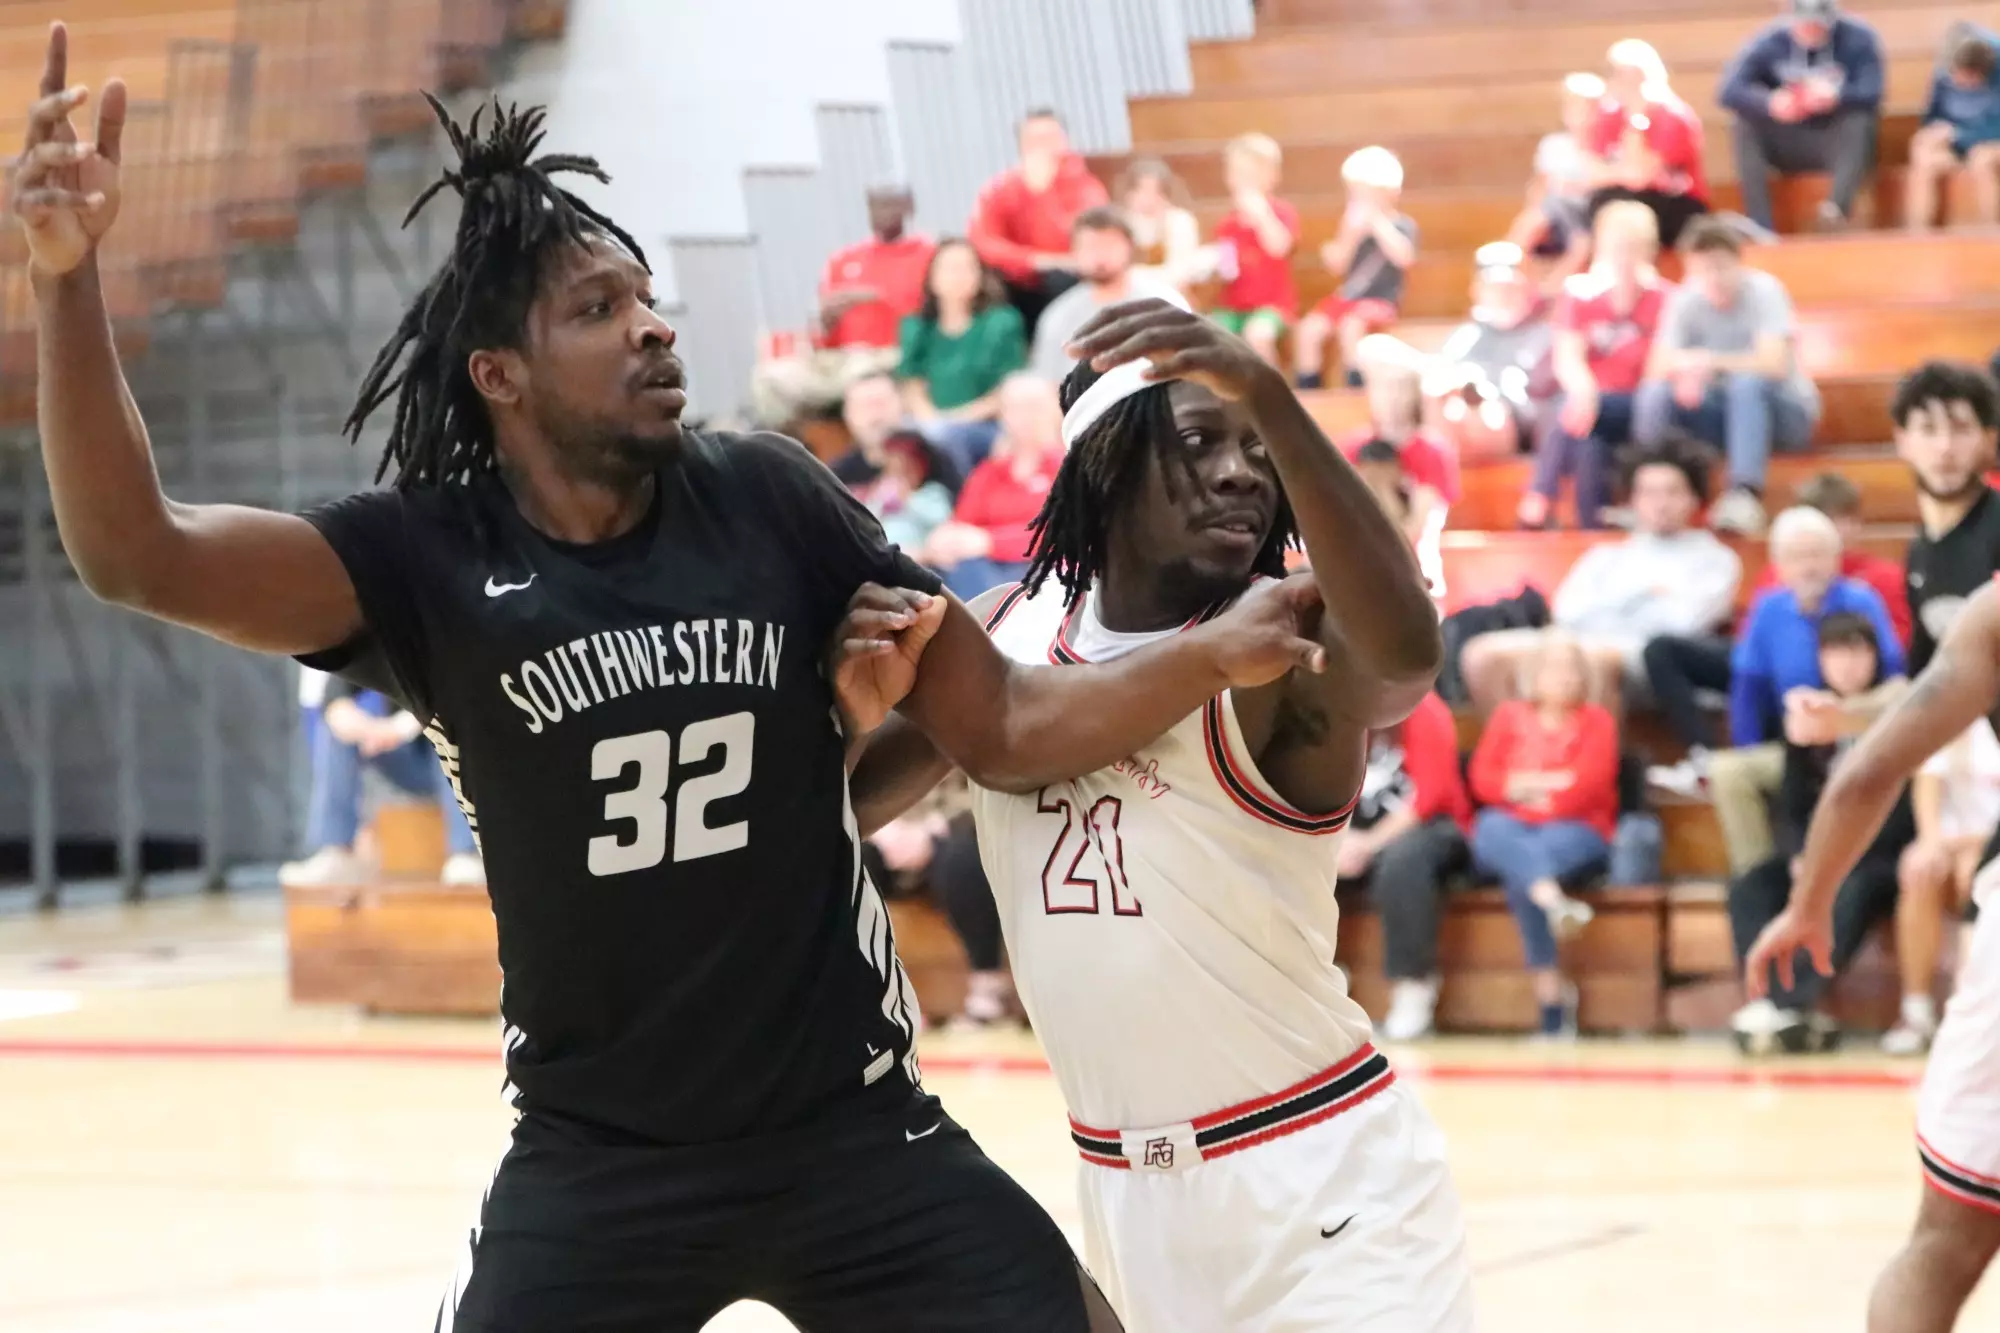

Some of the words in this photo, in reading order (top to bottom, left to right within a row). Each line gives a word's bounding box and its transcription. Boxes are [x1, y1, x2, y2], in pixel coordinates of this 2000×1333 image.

[501, 618, 785, 734] SOUTHWESTERN
[587, 711, 755, 876] 32
[1037, 784, 1143, 917] 21
